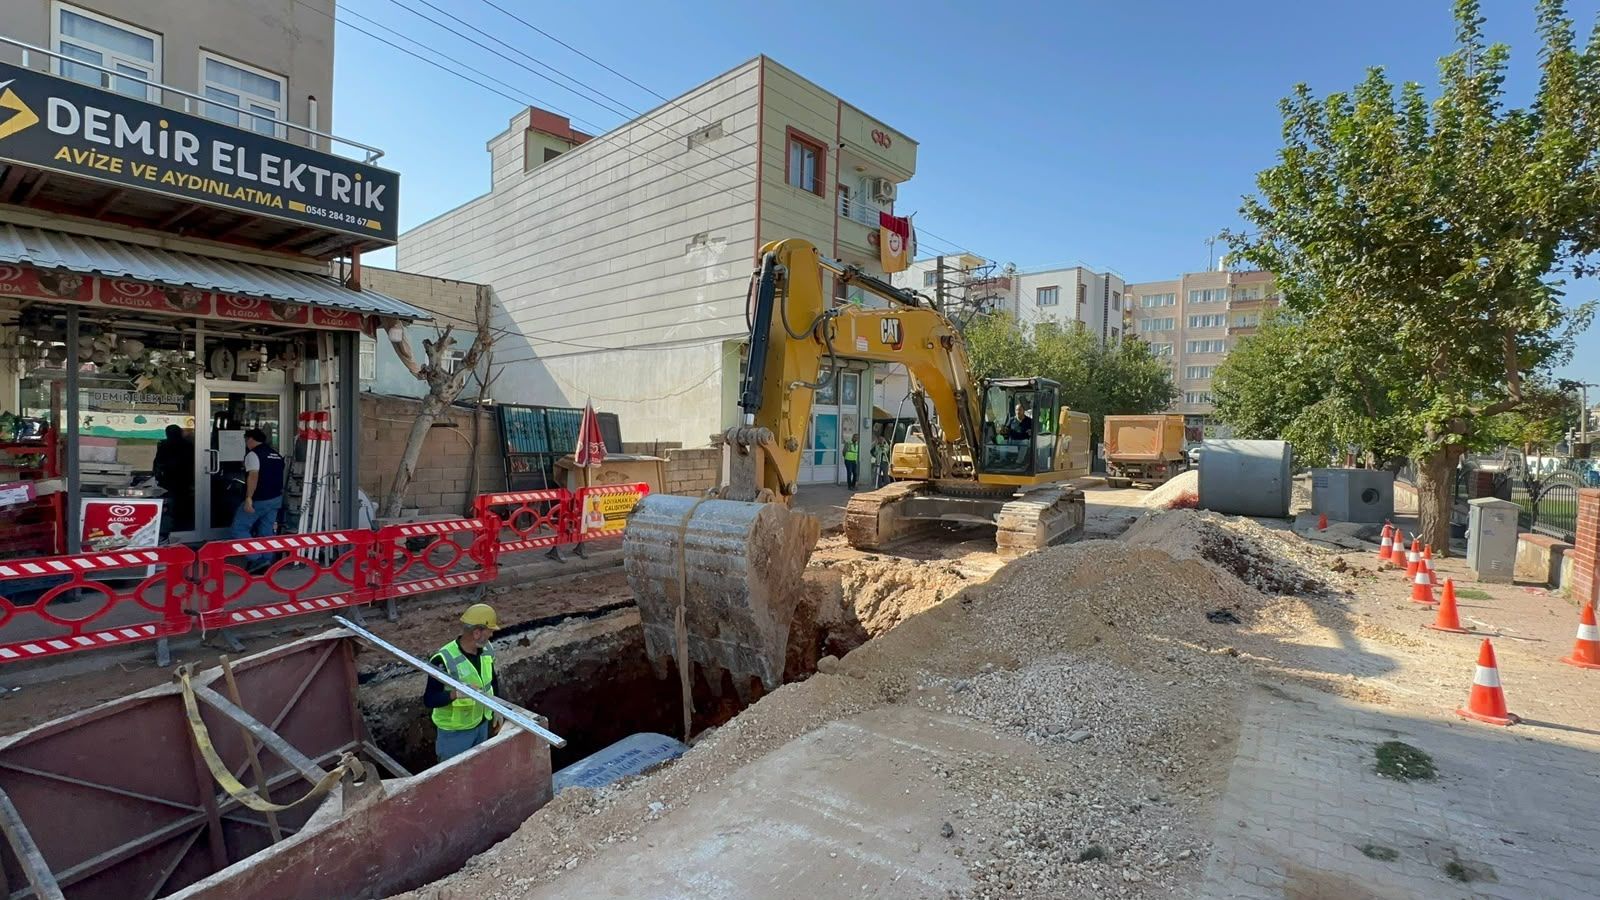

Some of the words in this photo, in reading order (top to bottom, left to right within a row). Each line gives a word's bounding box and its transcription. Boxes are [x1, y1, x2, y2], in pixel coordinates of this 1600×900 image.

[54, 146, 123, 174] AVİZE
[130, 161, 157, 181] VE
[160, 170, 283, 209] AYDINLATMA
[306, 205, 327, 217] 0545
[328, 210, 344, 221] 284
[345, 214, 355, 224] 28
[357, 217, 367, 226] 67
[110, 297, 152, 307] ALGIDA
[225, 309, 261, 319] ALGIDA
[321, 318, 350, 326] ALGIDA
[880, 318, 899, 344] CAT
